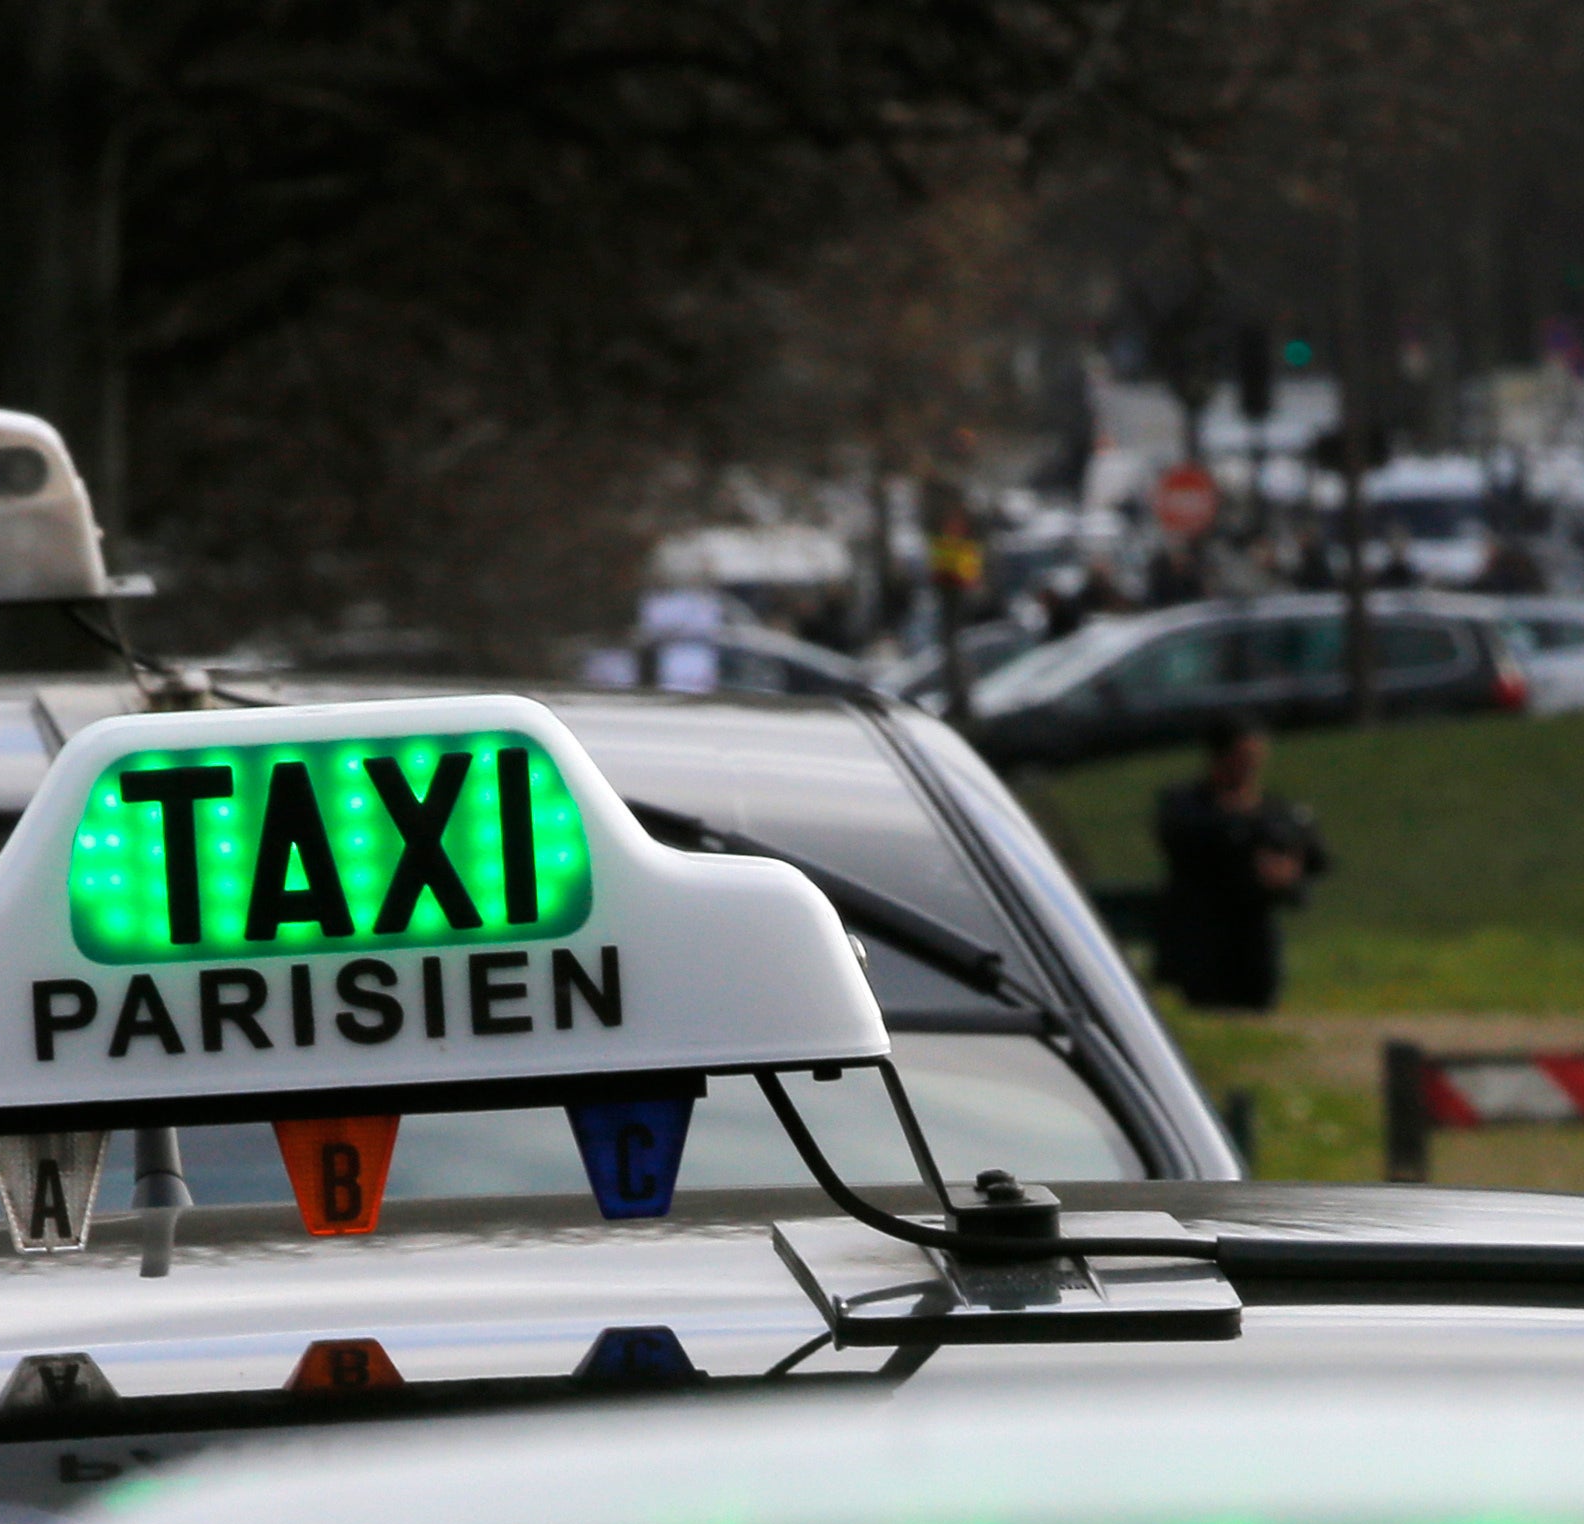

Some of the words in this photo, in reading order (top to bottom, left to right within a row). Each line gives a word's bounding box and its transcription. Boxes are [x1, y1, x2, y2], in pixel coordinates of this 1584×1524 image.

[119, 748, 539, 945] TAXI
[31, 945, 624, 1061] PARISIEN
[29, 1159, 72, 1240] A
[321, 1142, 363, 1223] B
[619, 1123, 656, 1201] C
